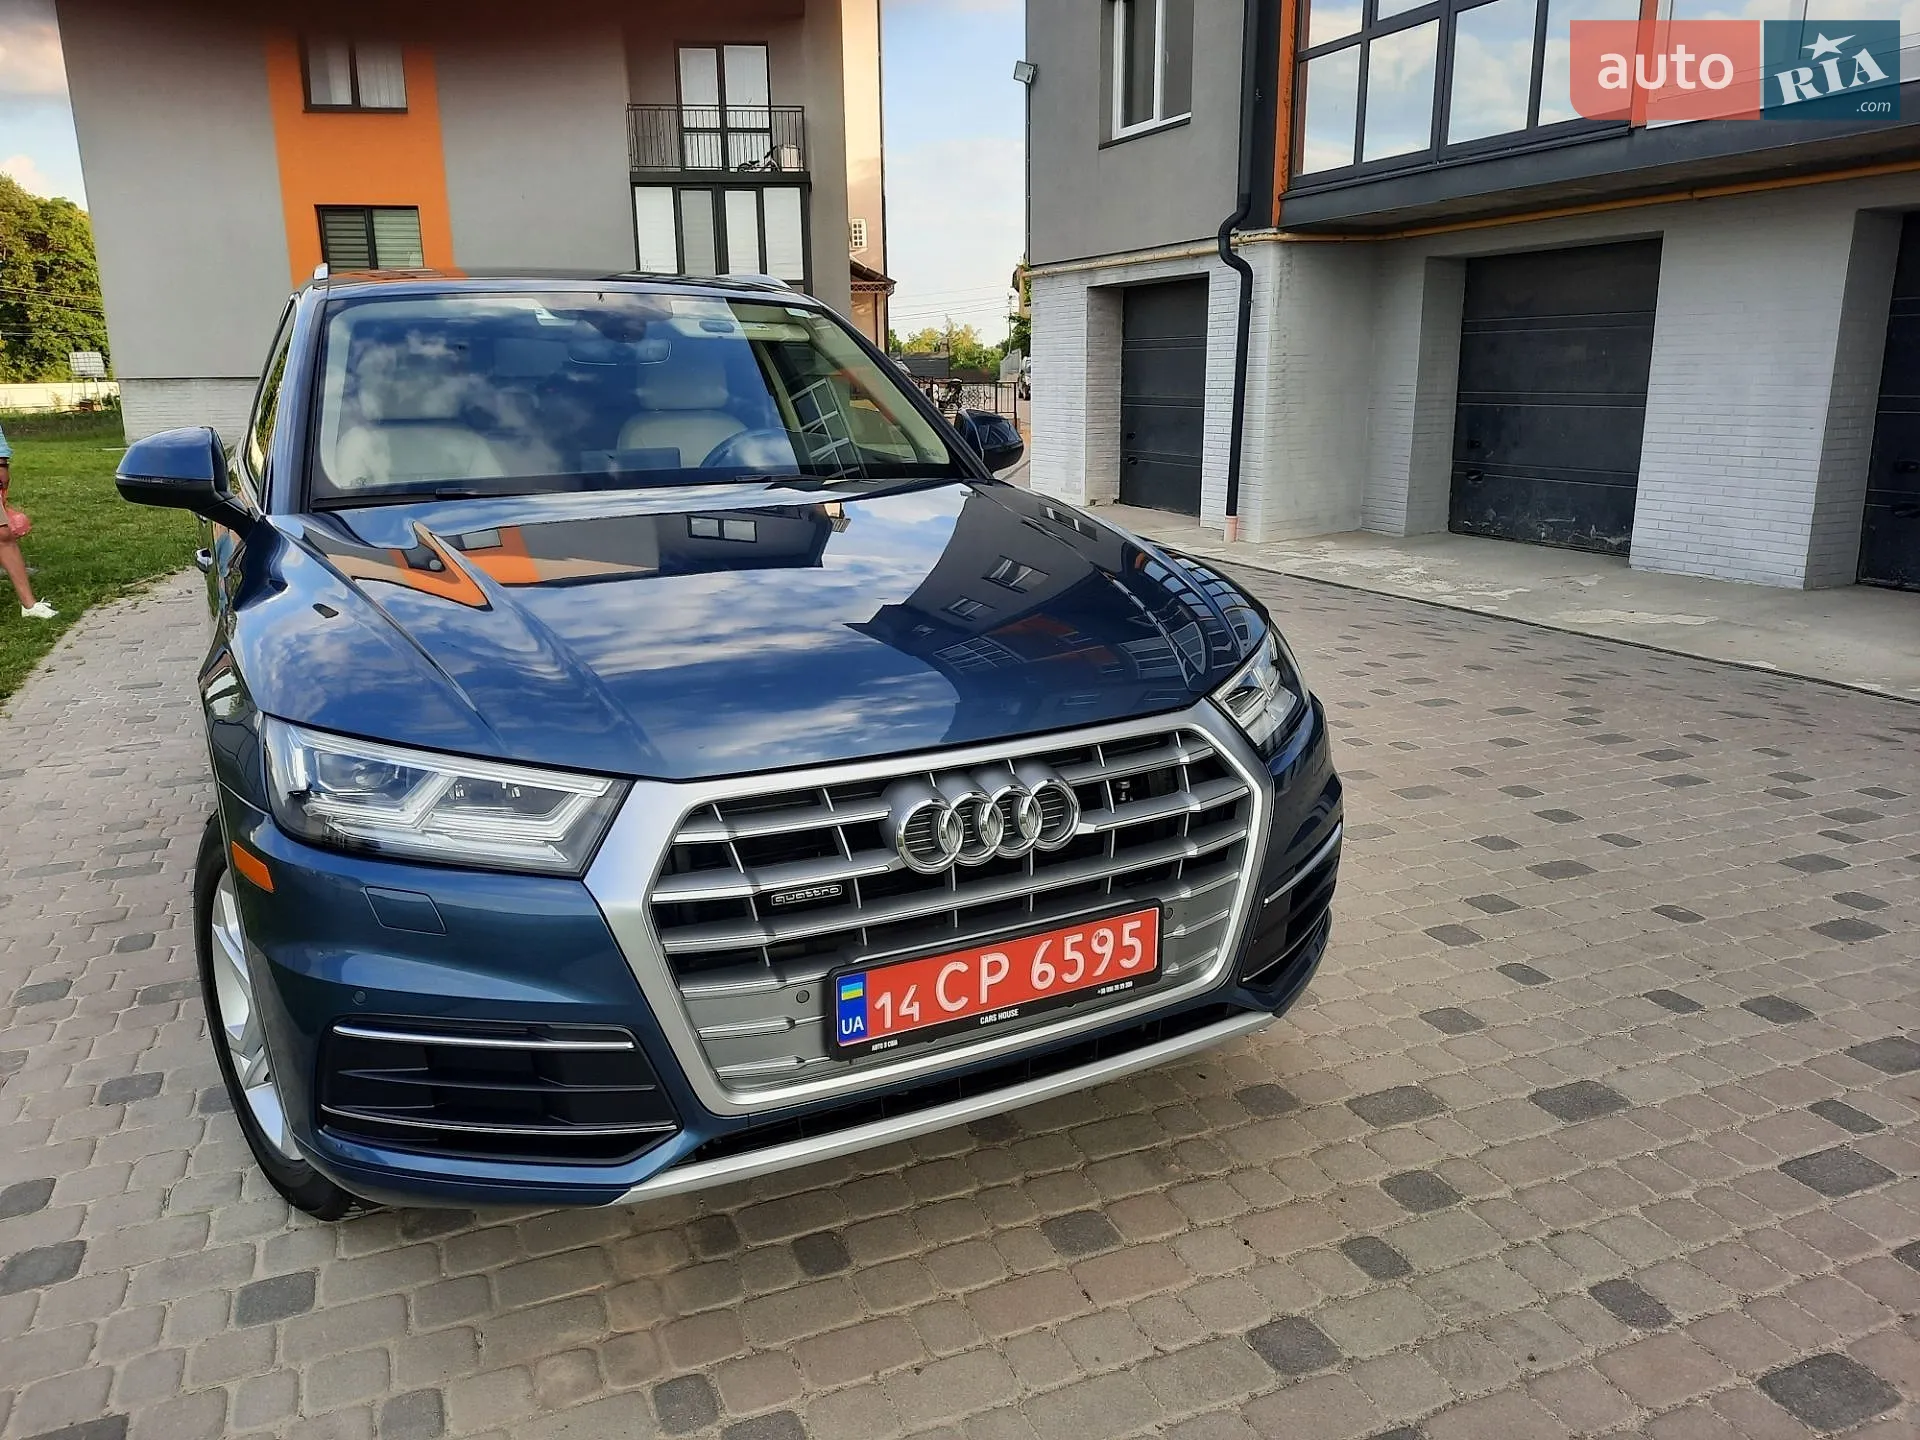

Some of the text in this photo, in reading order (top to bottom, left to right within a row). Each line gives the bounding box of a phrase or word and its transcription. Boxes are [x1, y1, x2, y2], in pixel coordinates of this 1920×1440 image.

[775, 887, 840, 903] quattro
[874, 920, 1142, 1029] 14 CP 6595
[841, 1015, 865, 1035] UA
[980, 1008, 1020, 1025] CARS HOUSE
